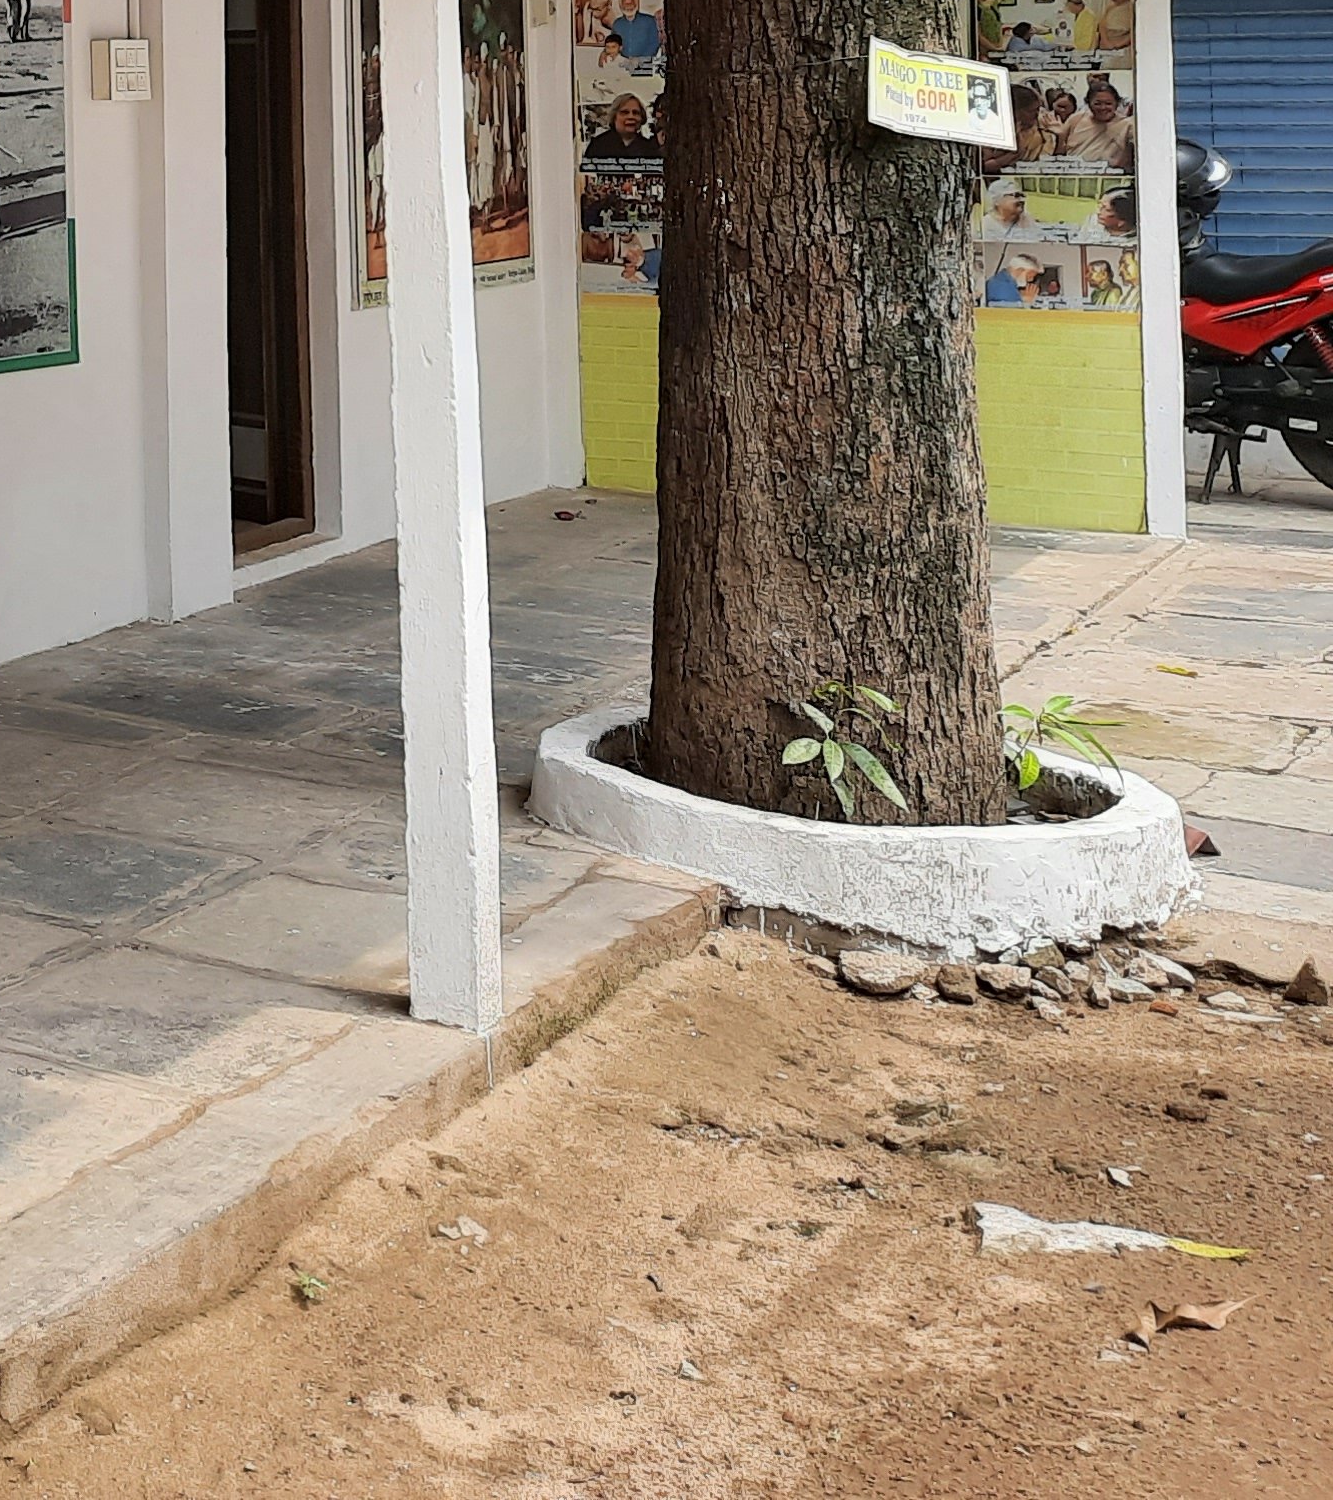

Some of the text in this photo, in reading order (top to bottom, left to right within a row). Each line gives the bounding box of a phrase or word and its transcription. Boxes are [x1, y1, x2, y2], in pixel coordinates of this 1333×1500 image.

[921, 69, 963, 91] TREE
[917, 89, 957, 113] GORA
[904, 113, 927, 124] 1974
